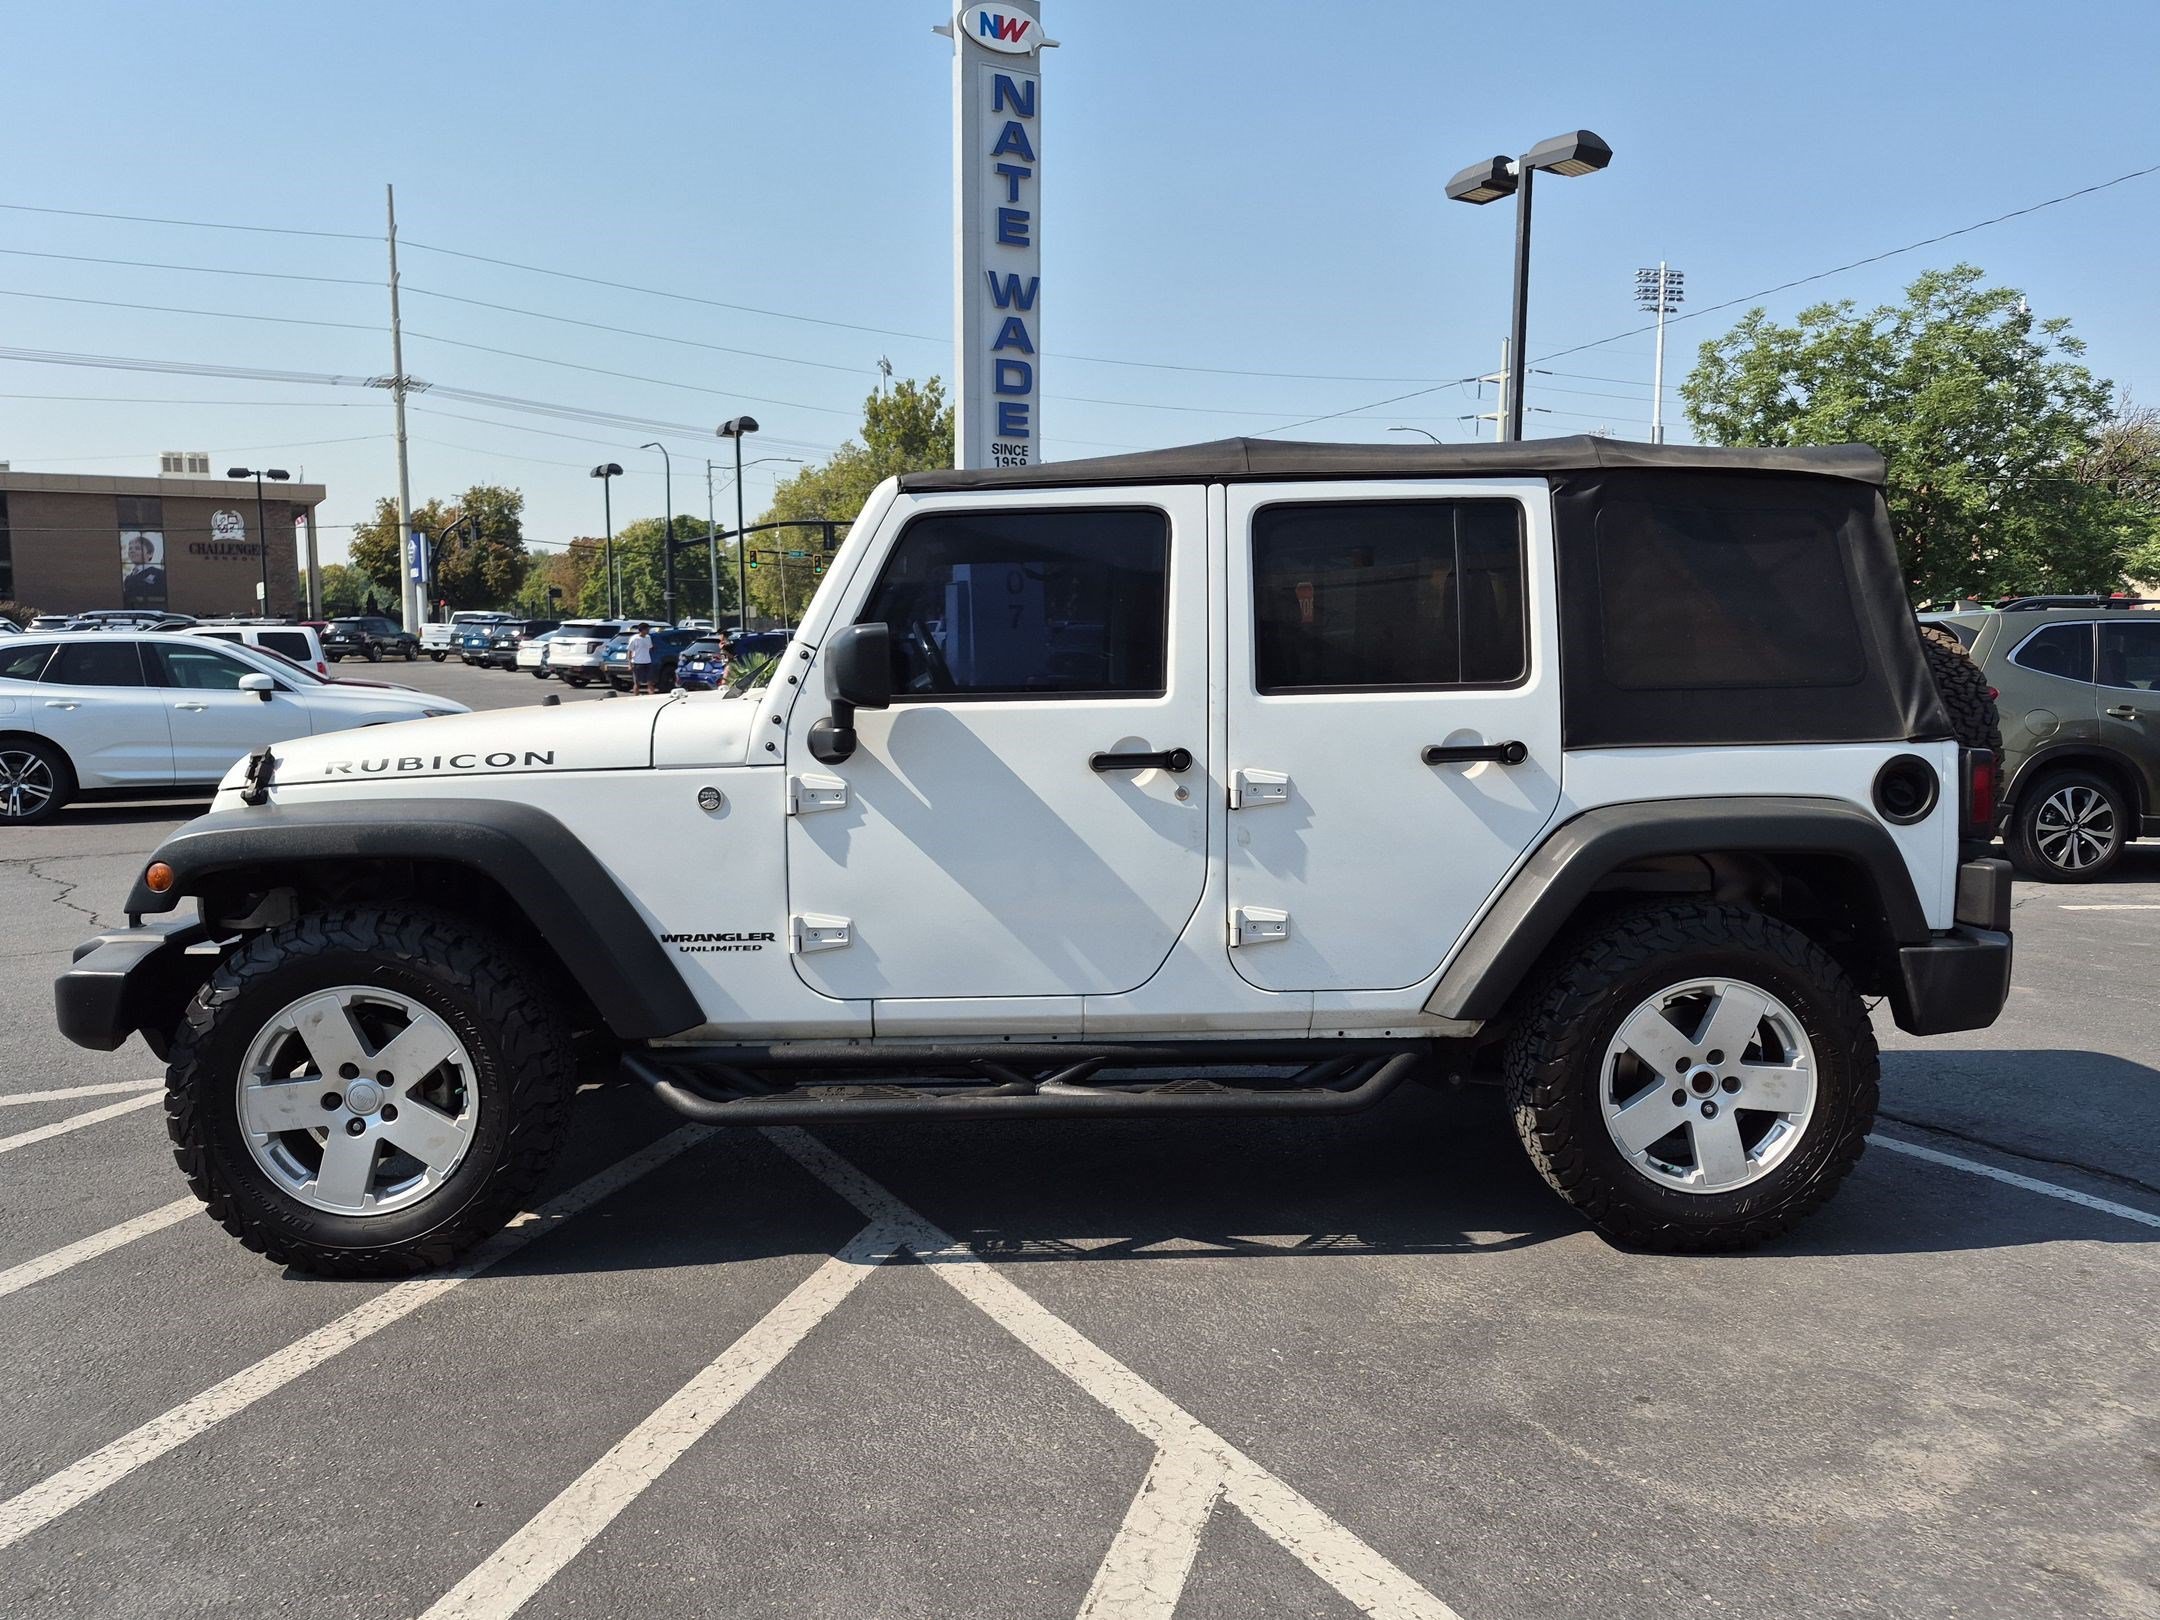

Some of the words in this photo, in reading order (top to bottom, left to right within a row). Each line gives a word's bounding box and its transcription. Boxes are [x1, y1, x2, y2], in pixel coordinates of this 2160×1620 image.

[980, 11, 1031, 43] NW
[991, 73, 1036, 247] NATE
[985, 270, 1040, 438] WADE
[992, 443, 1029, 457] SINCE
[325, 750, 555, 775] RUBICON
[660, 932, 776, 943] WRANGLER
[680, 945, 763, 953] UNLIMITED
